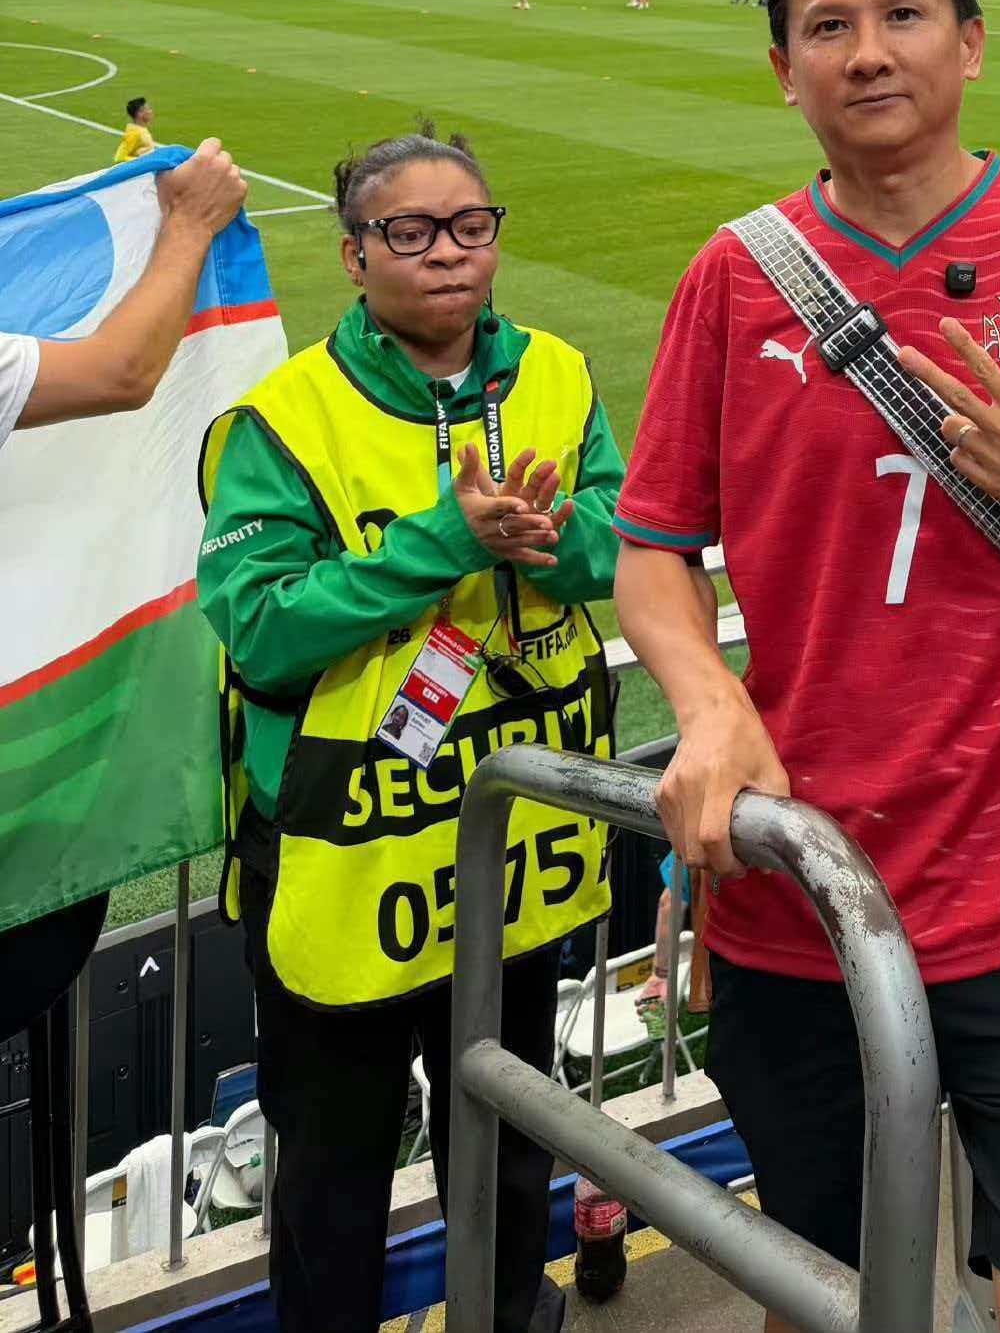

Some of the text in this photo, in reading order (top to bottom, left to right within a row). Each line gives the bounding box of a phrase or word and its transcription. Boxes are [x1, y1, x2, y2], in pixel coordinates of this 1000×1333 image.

[487, 403, 498, 430] FIFA
[438, 421, 449, 449] FIFA
[201, 519, 263, 555] SECURITY
[875, 453, 929, 605] 7
